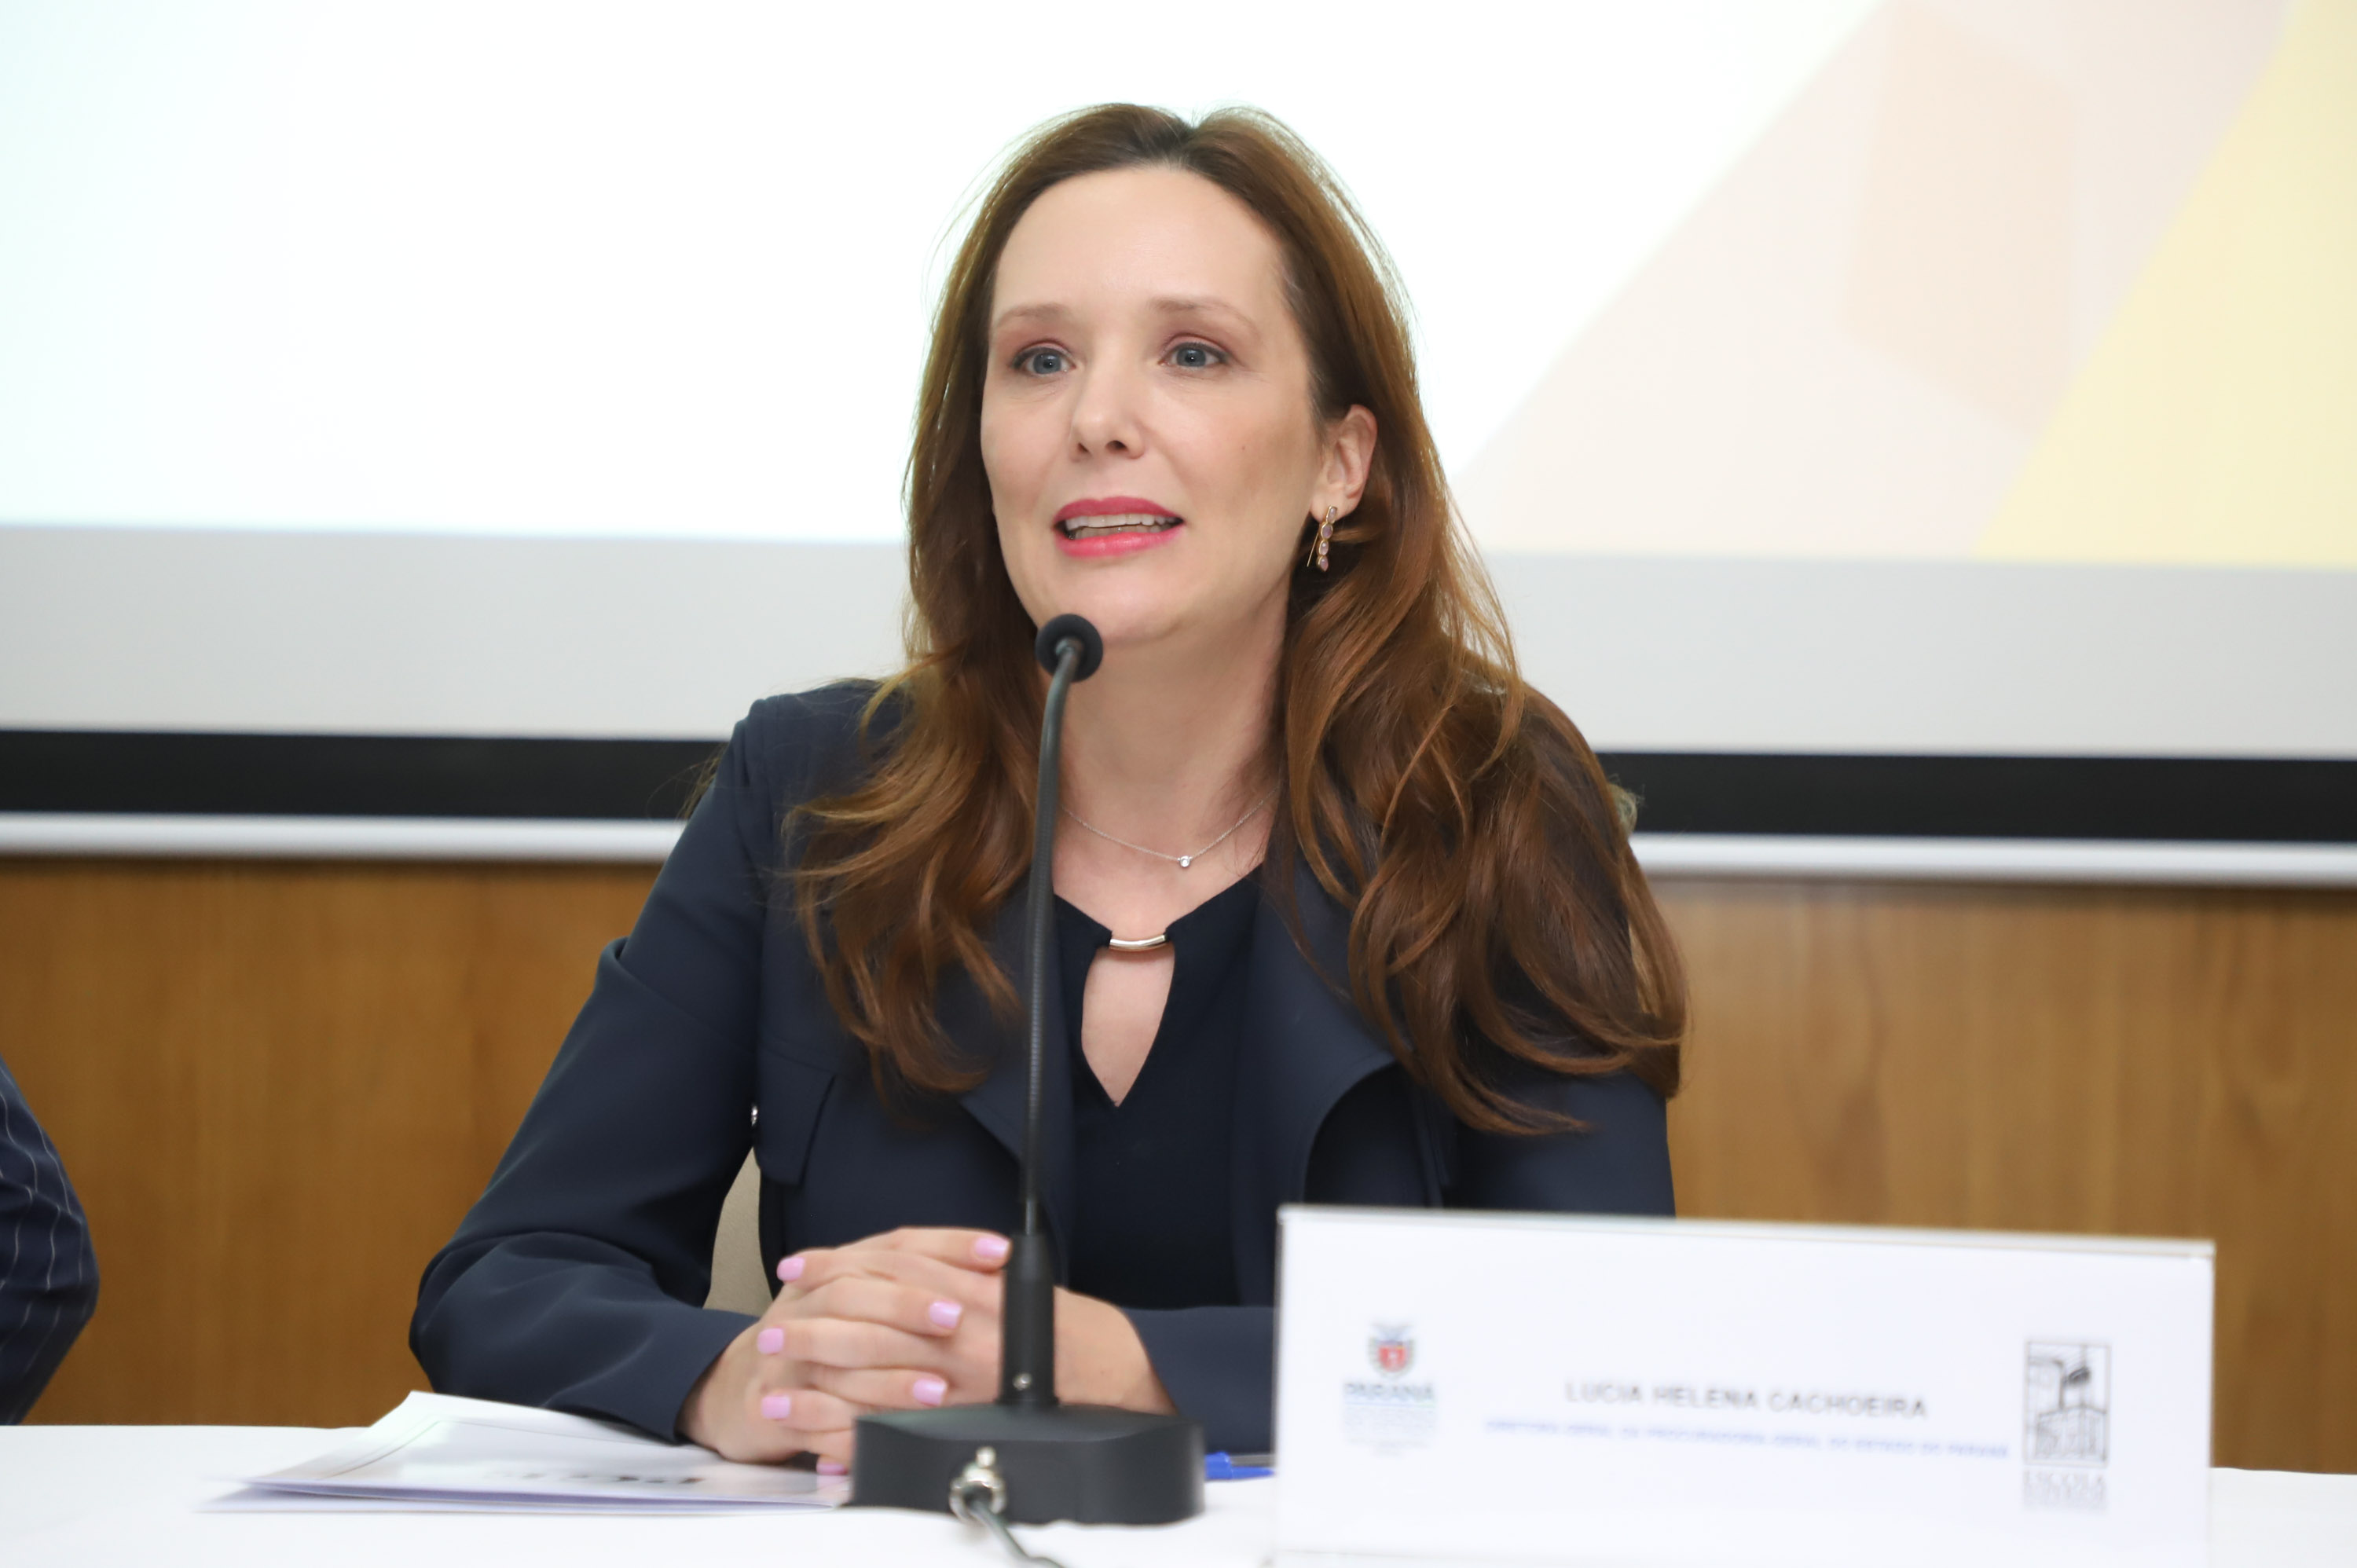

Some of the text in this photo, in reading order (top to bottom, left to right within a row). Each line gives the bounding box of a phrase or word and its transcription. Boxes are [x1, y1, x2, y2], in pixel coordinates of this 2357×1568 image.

[1565, 1382, 1927, 1418] LUCIA HELENA CACHOEIRA
